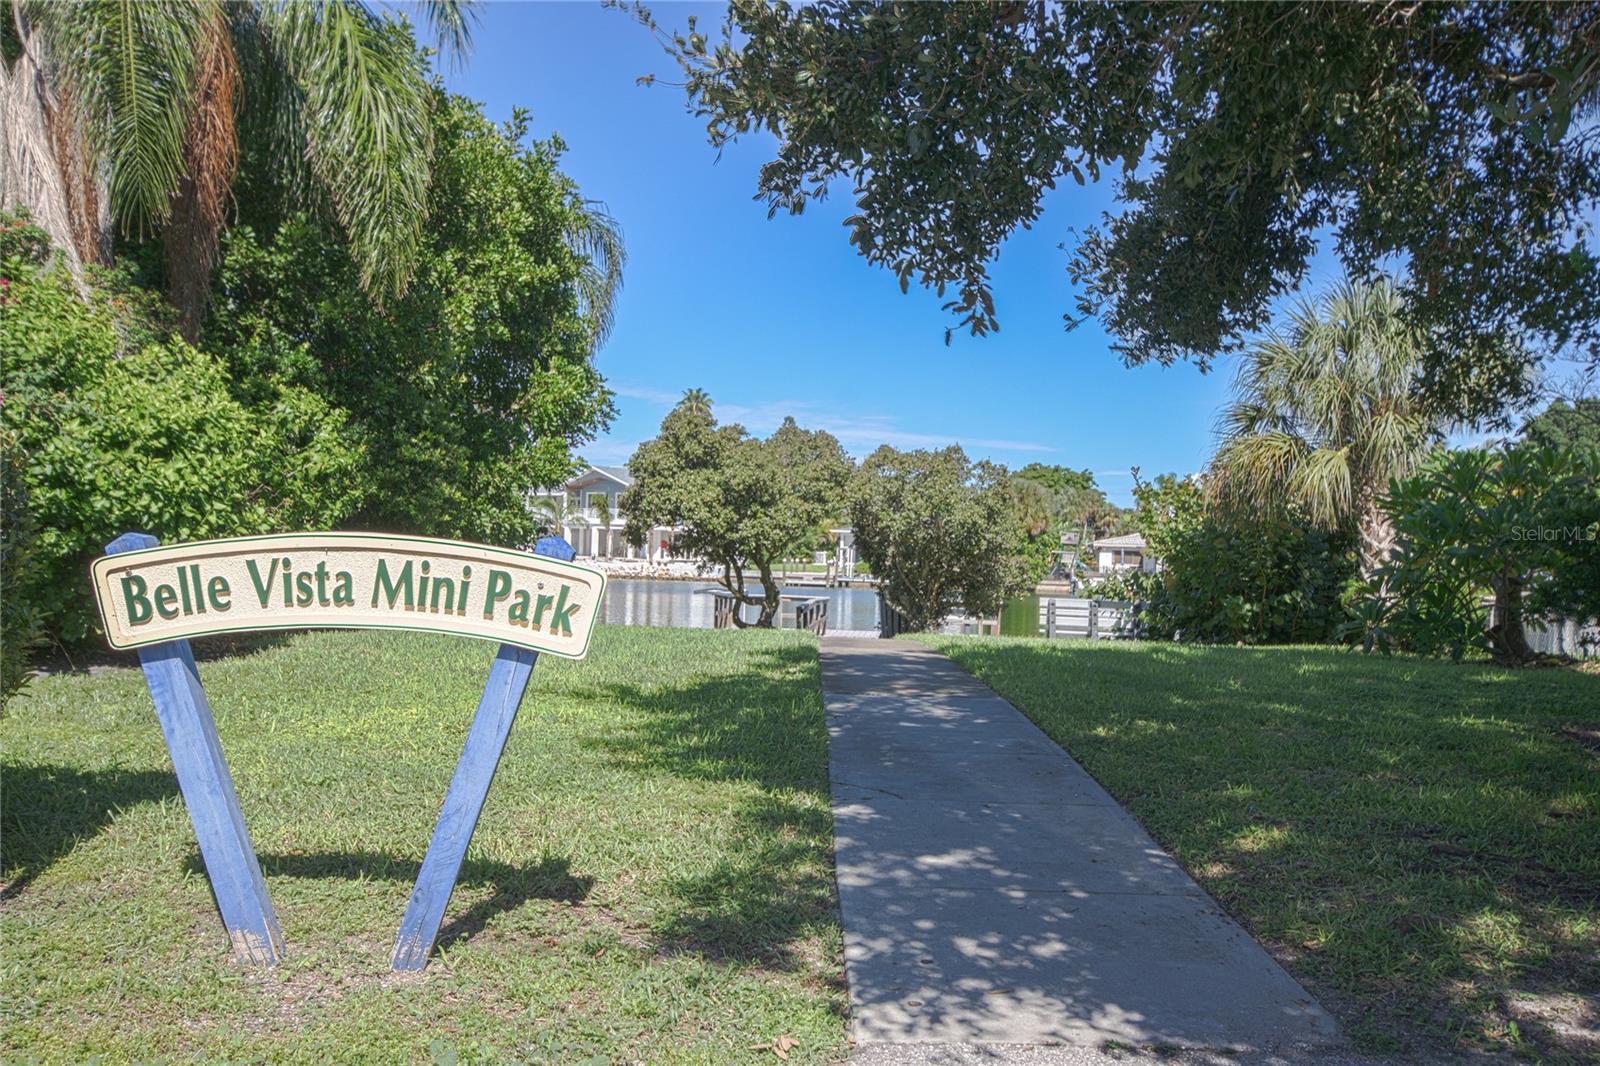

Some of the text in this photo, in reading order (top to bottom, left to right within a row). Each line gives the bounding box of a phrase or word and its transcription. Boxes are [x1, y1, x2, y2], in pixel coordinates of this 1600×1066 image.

[120, 557, 582, 637] Belle Vista Mini Park
